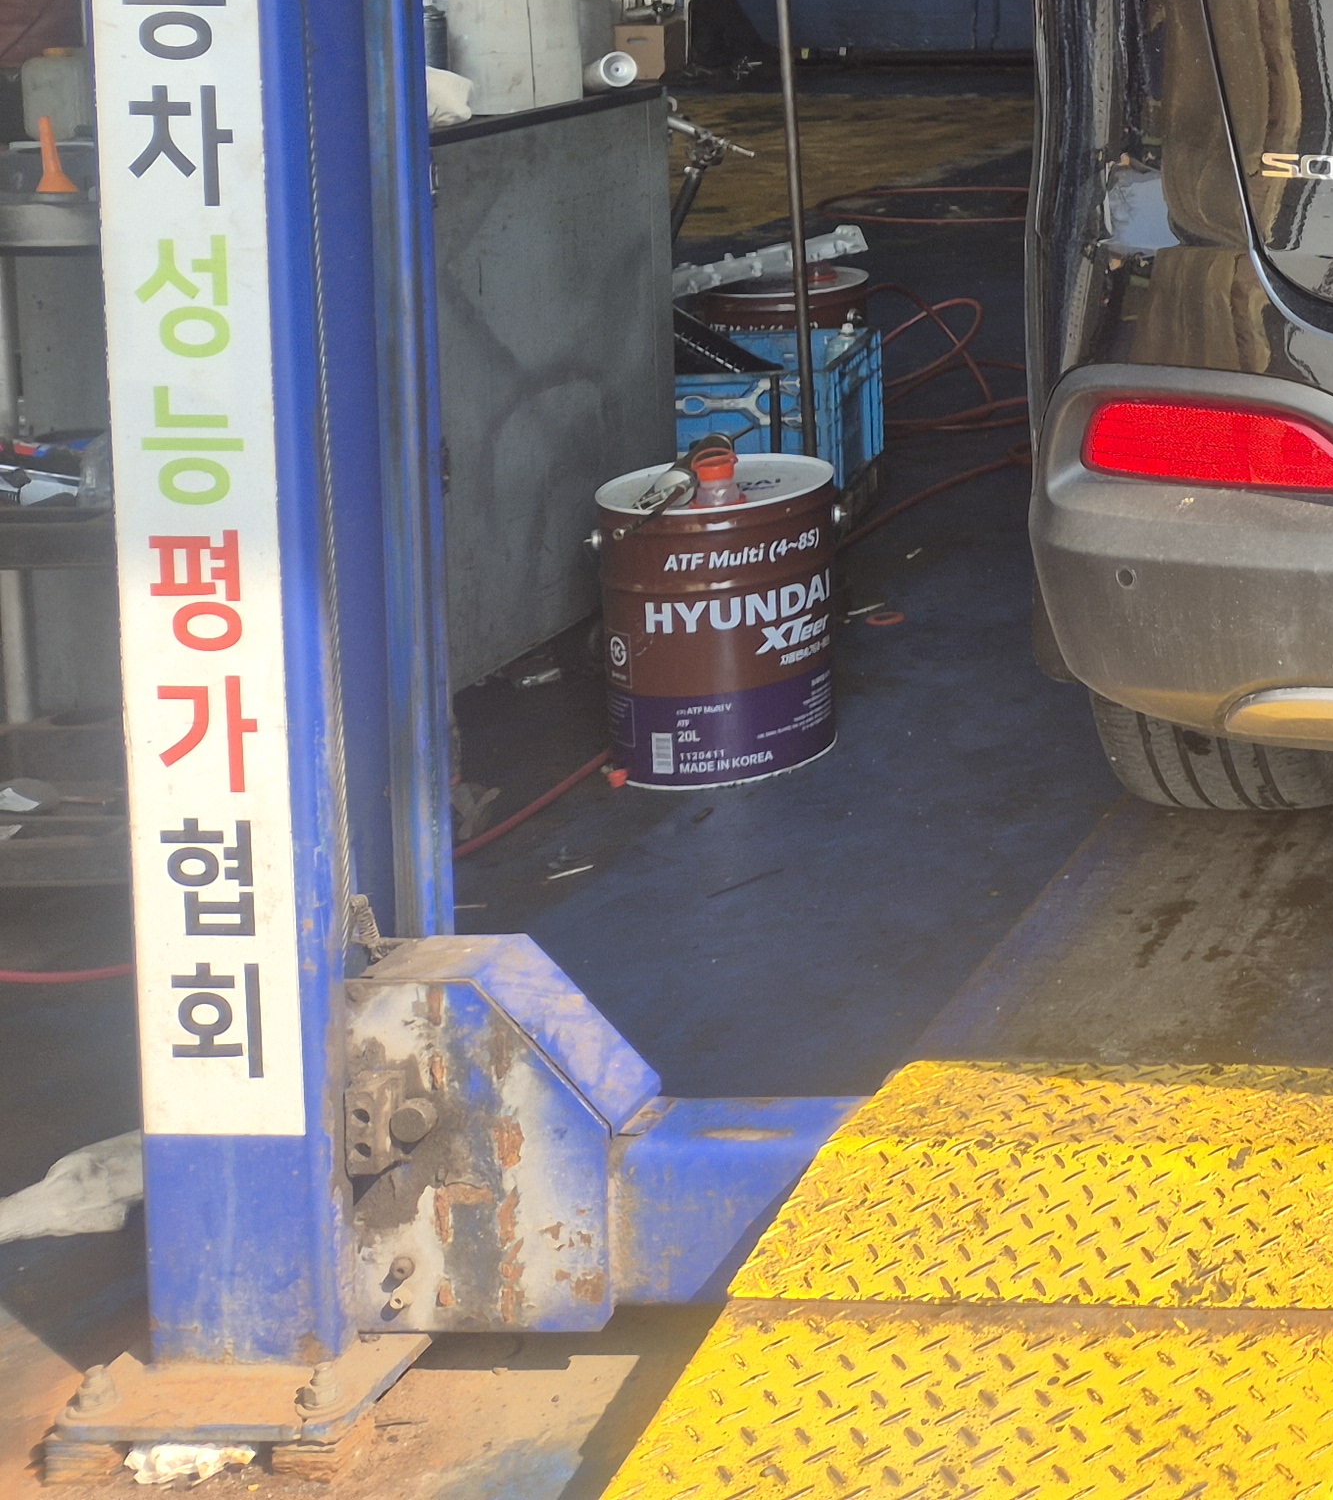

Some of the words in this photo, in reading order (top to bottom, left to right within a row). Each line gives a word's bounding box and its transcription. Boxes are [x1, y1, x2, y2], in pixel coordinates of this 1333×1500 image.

[663, 551, 705, 573] ATF
[708, 541, 765, 570] Multi
[768, 526, 821, 563] (4~8S)
[644, 567, 831, 636] HYUNDAI
[677, 730, 701, 743] 20L
[678, 760, 715, 774] MADE
[716, 758, 730, 771] IN
[731, 750, 774, 769] KOREA
